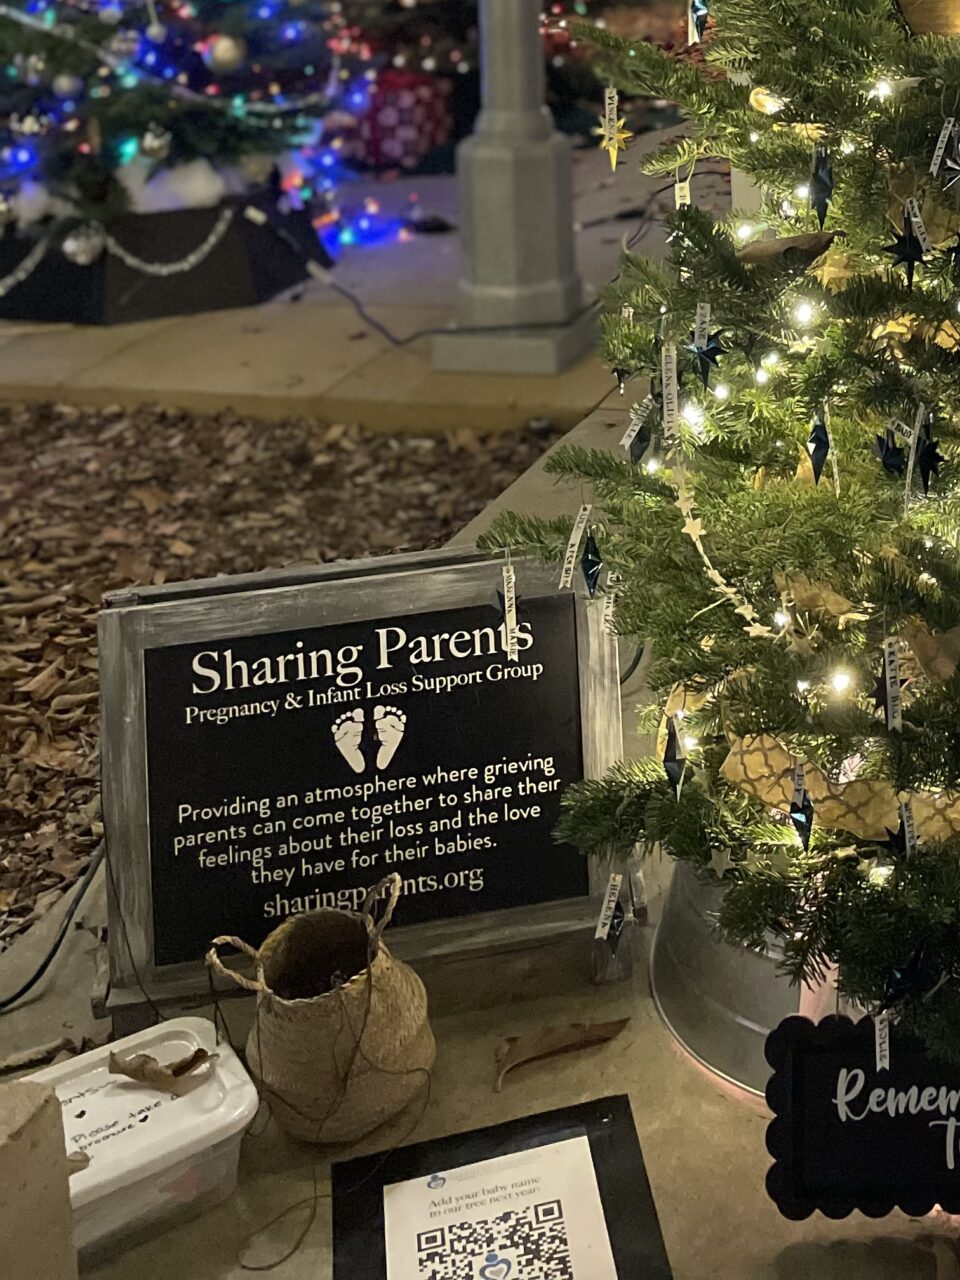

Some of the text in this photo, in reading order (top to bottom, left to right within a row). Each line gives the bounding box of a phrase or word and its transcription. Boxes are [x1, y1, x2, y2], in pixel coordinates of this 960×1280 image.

[193, 620, 534, 694] Sharing Parents
[186, 664, 543, 724] Pregnancy & Infant Loss Support Group
[175, 777, 561, 855] parents can come together to share their
[179, 753, 555, 823] Providing an atmosphere where grieving
[199, 803, 540, 868] feelings about their loss and the love
[251, 833, 496, 887] they have for their babies.
[264, 867, 484, 918] sharingprnts.org
[428, 1177, 541, 1210] Add your baby name
[429, 1210, 442, 1219] to
[443, 1205, 463, 1216] our
[465, 1200, 489, 1211] tree
[489, 1192, 513, 1204] next
